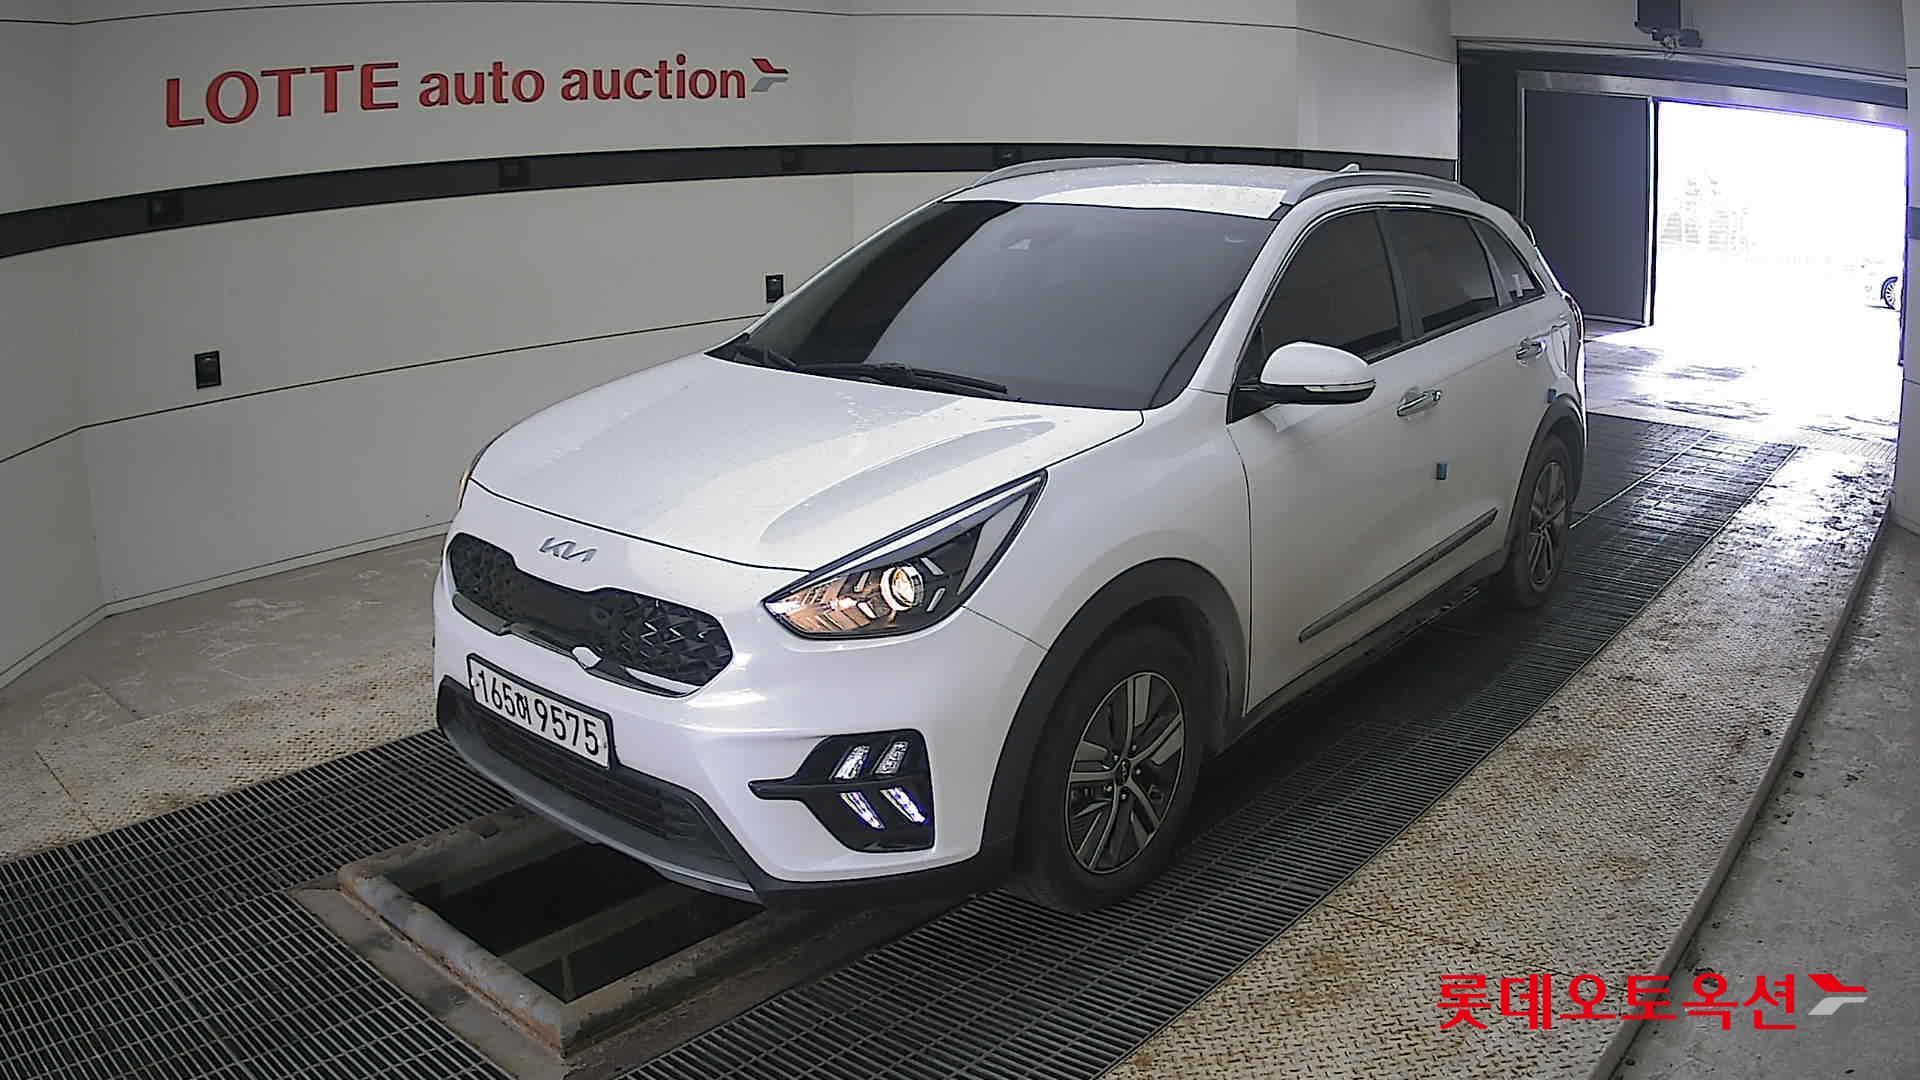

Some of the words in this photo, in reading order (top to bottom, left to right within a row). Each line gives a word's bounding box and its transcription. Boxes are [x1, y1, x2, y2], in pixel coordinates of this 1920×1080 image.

[165, 62, 400, 128] LOTTE
[418, 61, 546, 107] auto
[560, 53, 747, 101] auction
